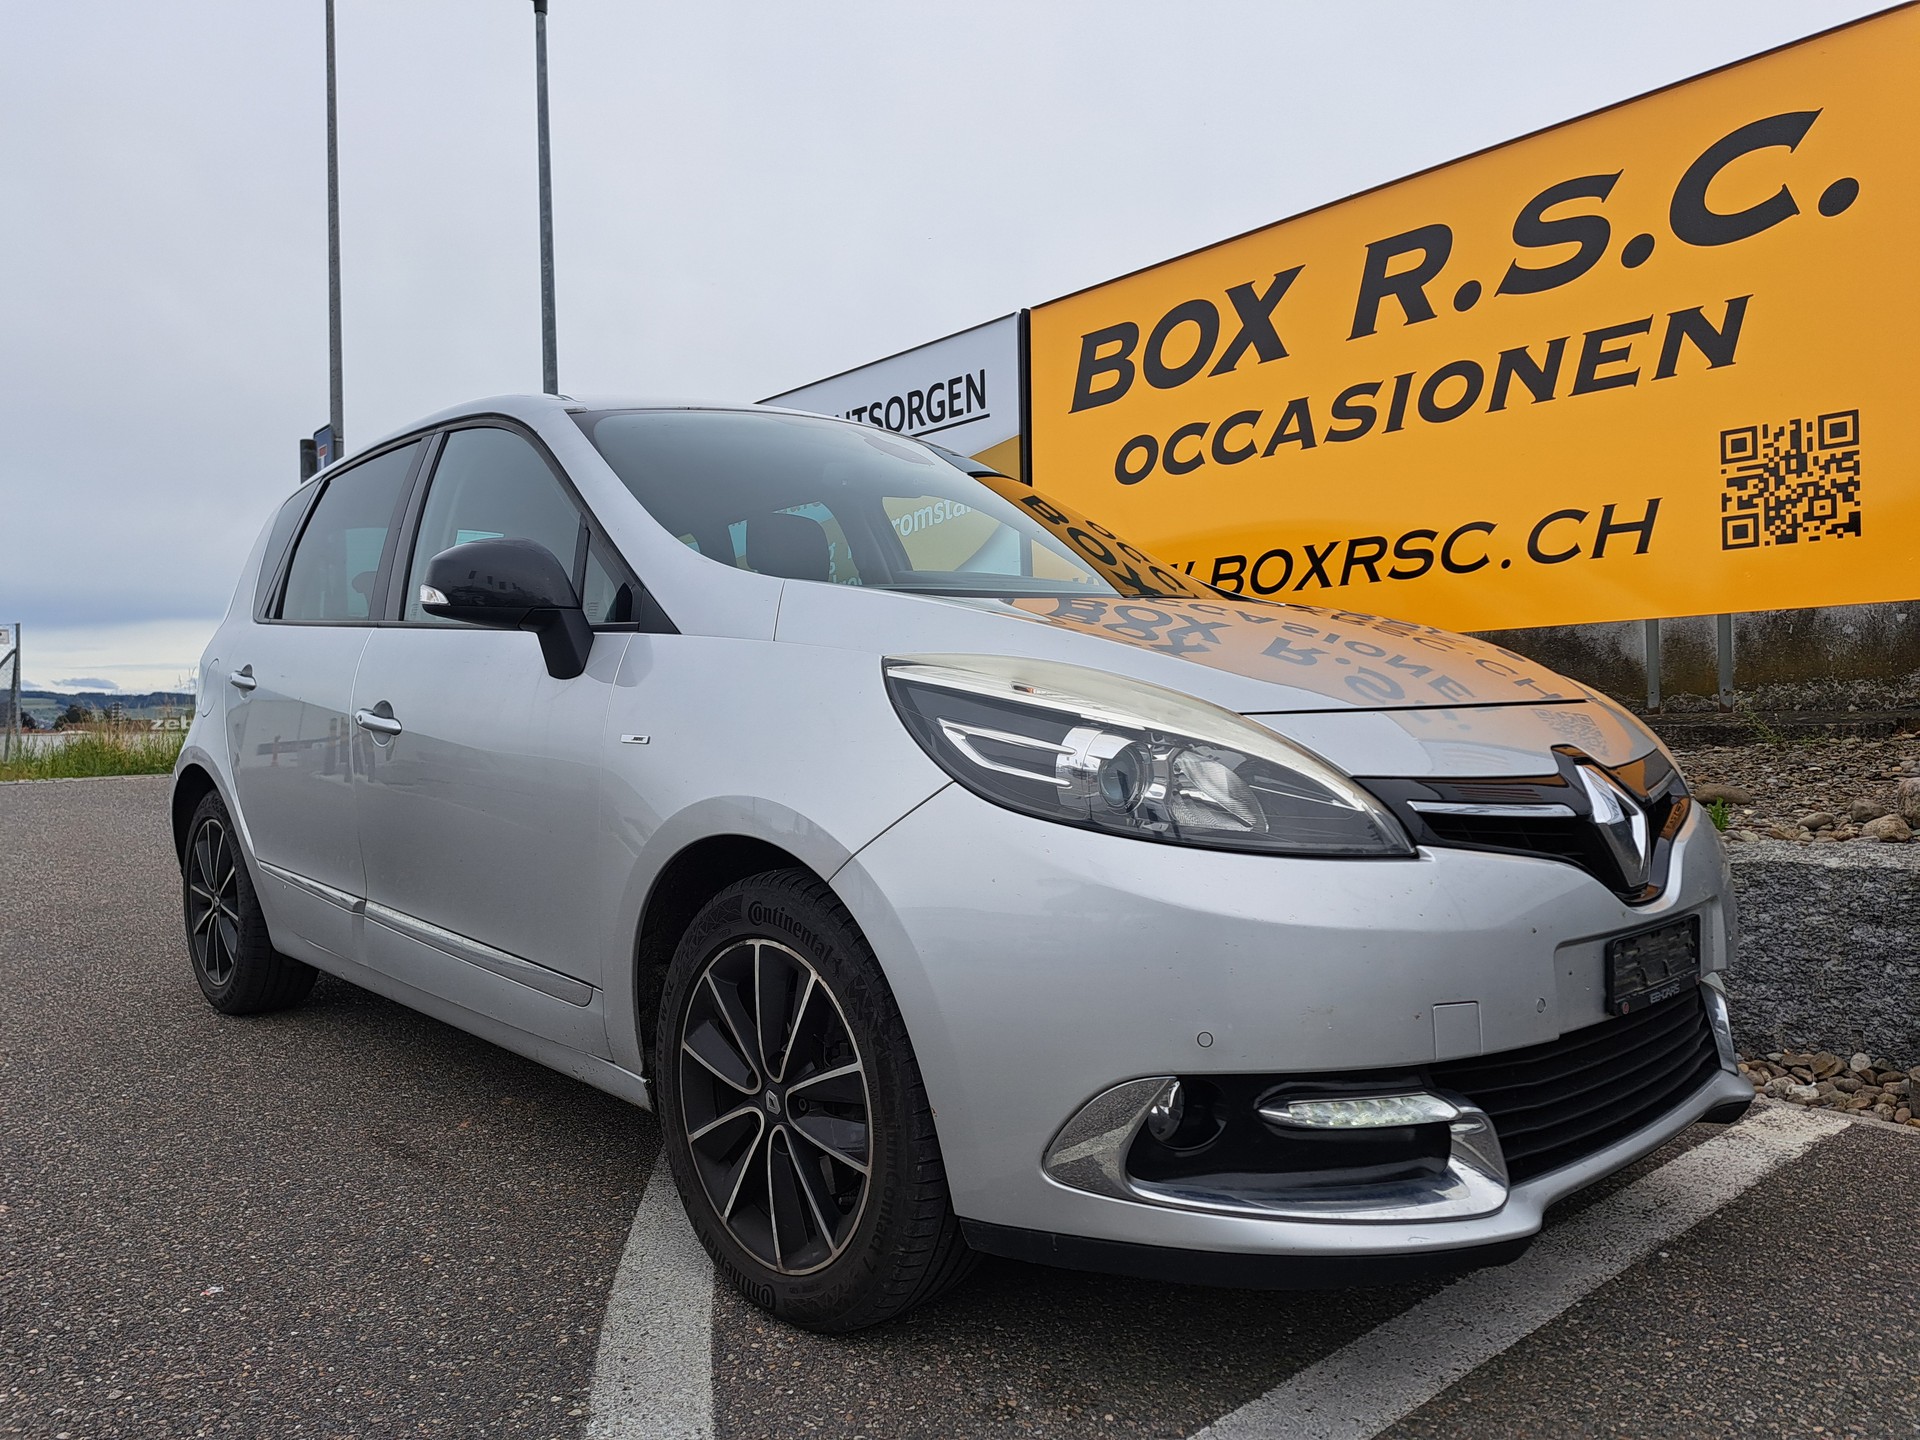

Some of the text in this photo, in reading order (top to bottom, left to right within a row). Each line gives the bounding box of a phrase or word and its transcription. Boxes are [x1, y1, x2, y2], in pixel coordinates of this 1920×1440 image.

[1069, 107, 1861, 414] BOX R.S.C.
[834, 368, 986, 433] TSORGEN
[1114, 294, 1754, 486] OCCASIONEN
[1171, 497, 1663, 596] BOXRSC.CH
[748, 901, 834, 967] Continental
